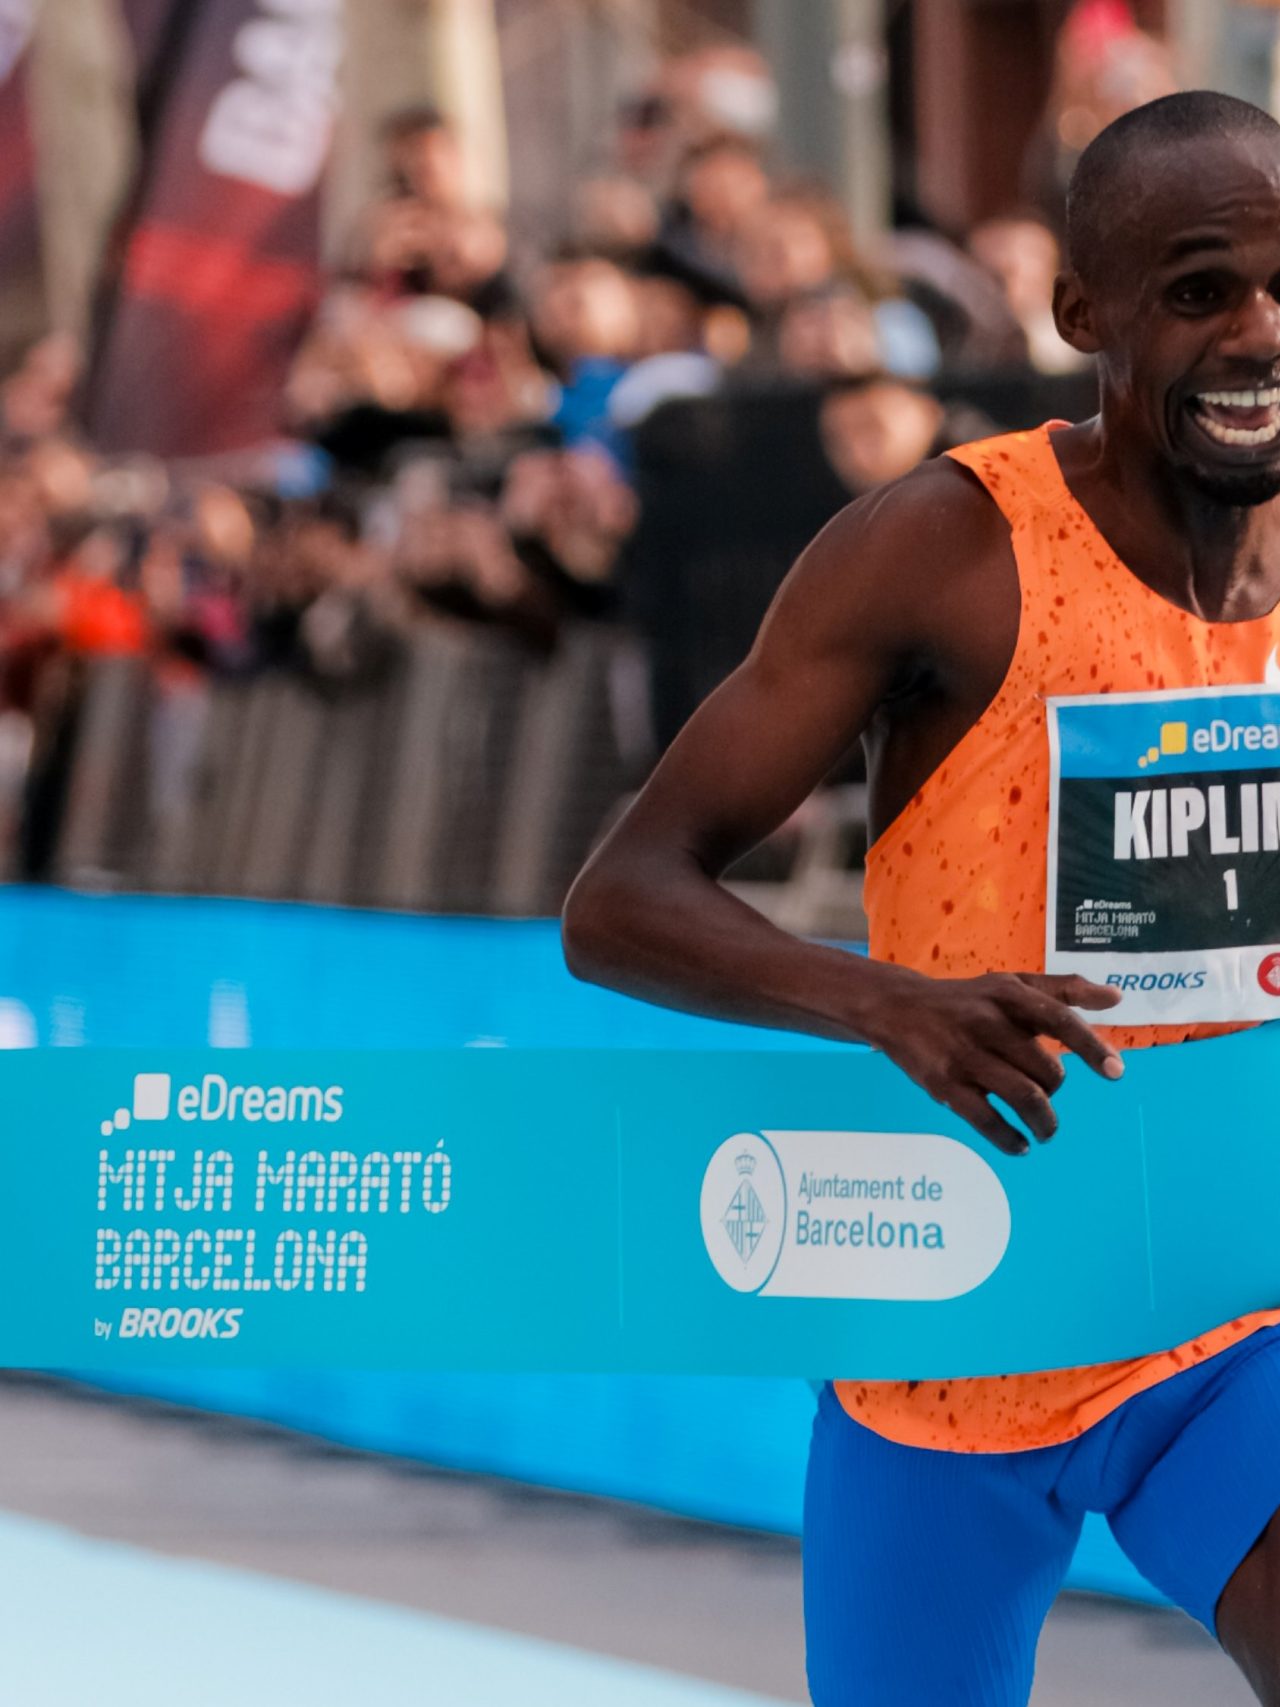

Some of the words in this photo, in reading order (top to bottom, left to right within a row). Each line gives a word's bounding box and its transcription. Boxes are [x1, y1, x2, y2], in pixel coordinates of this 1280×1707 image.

[1223, 869, 1238, 910] 1
[1075, 924, 1139, 936] BARCELONA
[177, 1073, 344, 1122] eDreams
[97, 1149, 234, 1212] MITJA
[255, 1138, 452, 1214] MARATÓ
[798, 1172, 905, 1205] Ajuntament
[911, 1175, 943, 1201] de
[795, 1210, 945, 1249] Barcelona
[95, 1228, 368, 1292] BARCELONA
[94, 1318, 112, 1340] by
[118, 1307, 244, 1338] BROOKS
